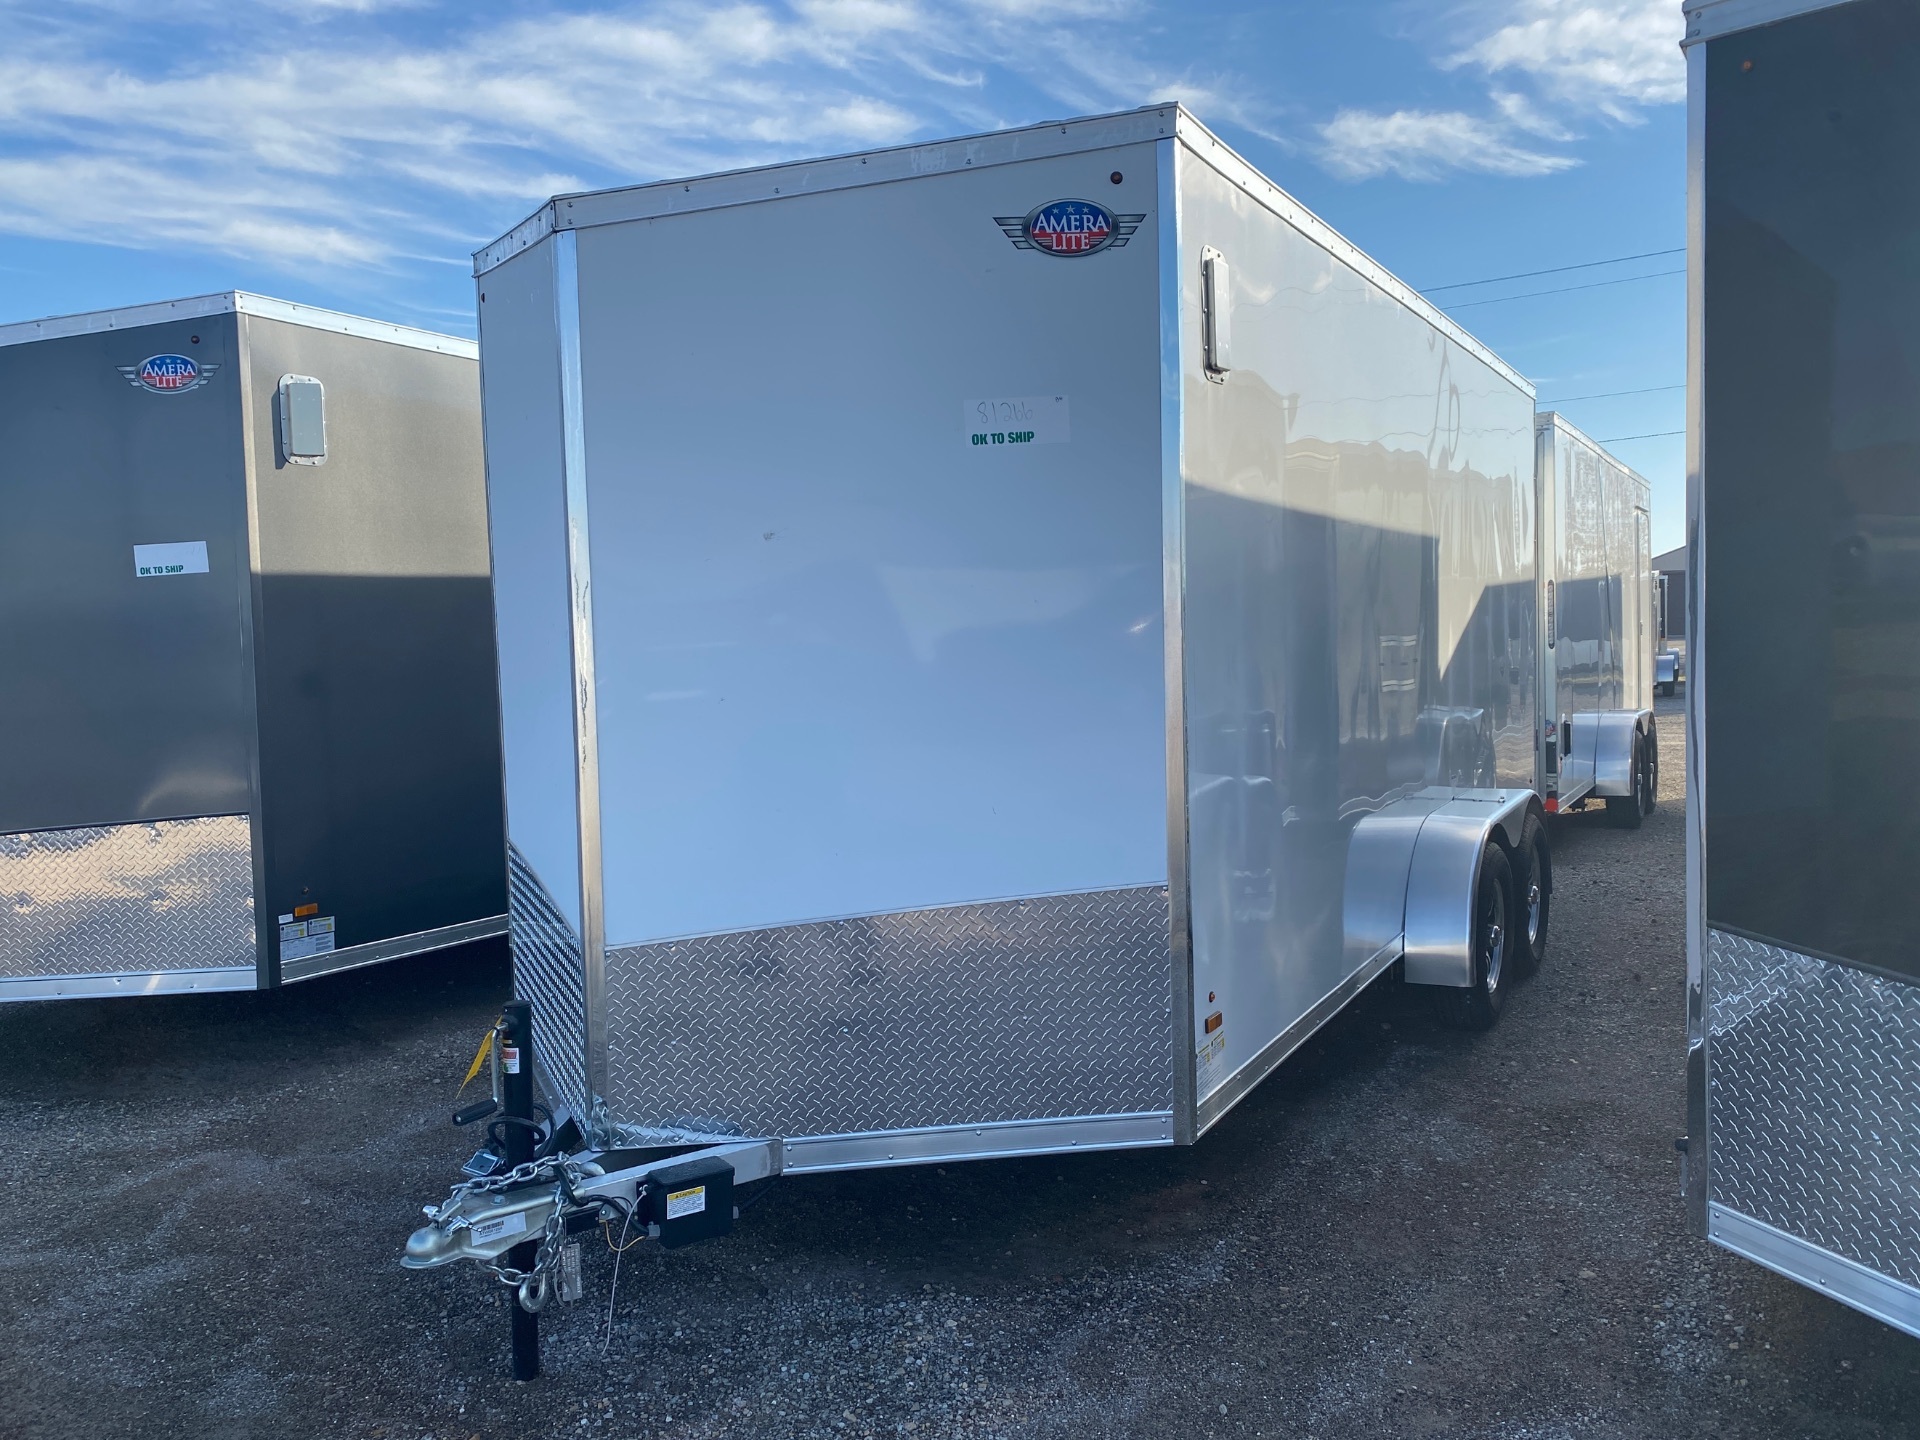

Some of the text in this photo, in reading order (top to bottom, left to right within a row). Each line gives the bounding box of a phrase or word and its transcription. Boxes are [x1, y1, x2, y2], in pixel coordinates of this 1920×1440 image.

[1033, 213, 1110, 233] AMERA
[1051, 232, 1090, 250] LITE
[142, 363, 196, 377] AMERA
[155, 376, 183, 387] LITE
[971, 431, 1035, 445] OK TO SHIP
[140, 565, 184, 575] OK TO SHIP
